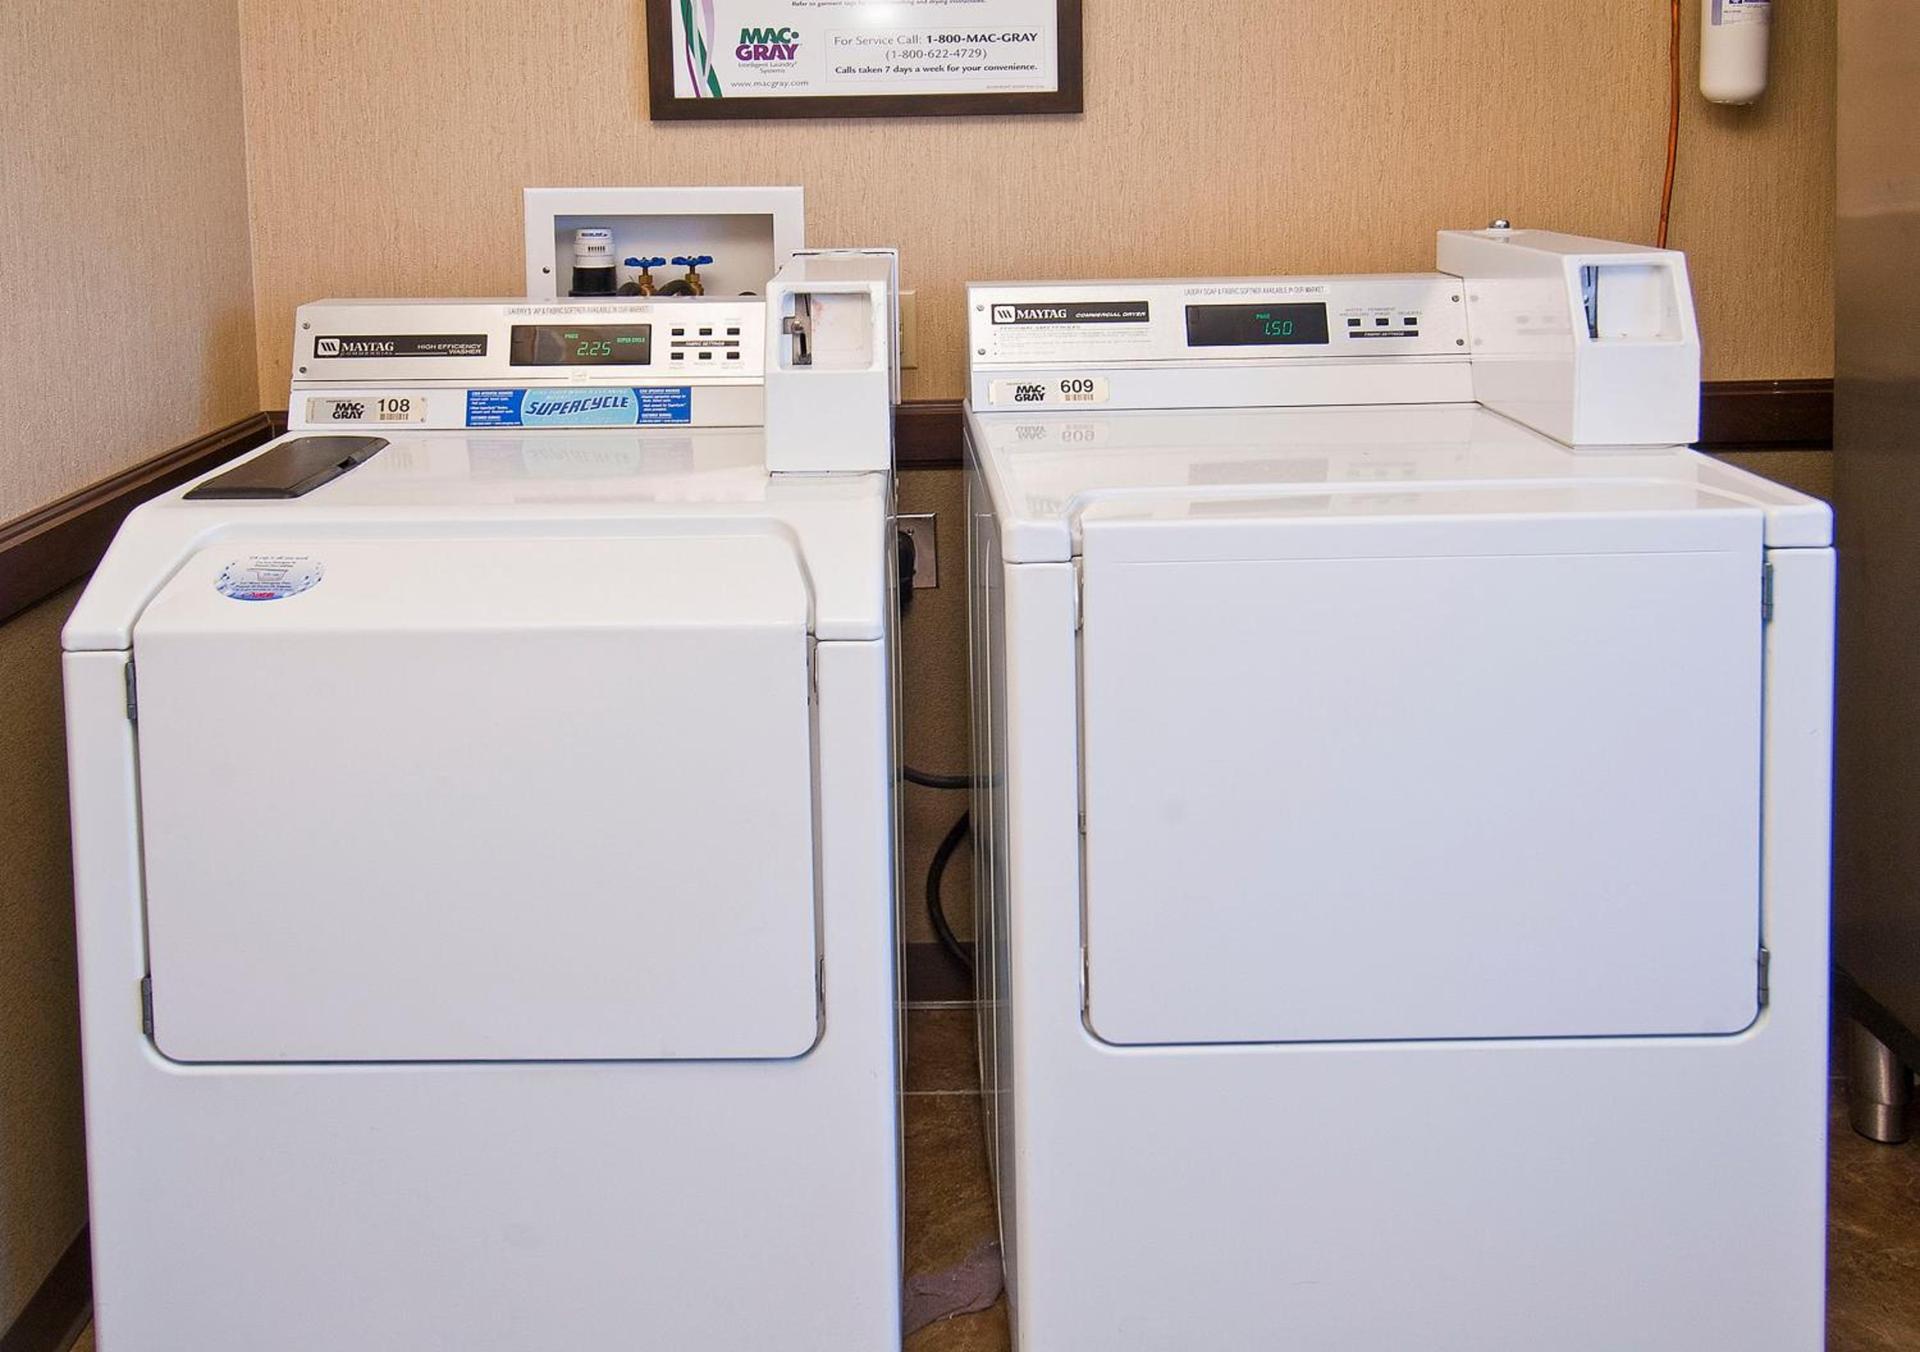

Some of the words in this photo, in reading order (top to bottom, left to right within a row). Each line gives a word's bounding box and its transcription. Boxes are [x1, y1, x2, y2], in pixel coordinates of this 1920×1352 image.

[834, 36, 852, 45] For
[855, 36, 894, 45] Service
[896, 34, 922, 44] Call:
[927, 32, 1038, 43] 1-800-MAC-GRAY
[735, 44, 799, 61] GRAY
[885, 48, 988, 61] (1-800-622-4729)
[835, 66, 856, 74] Calls
[893, 65, 913, 74] days
[946, 64, 960, 72] for
[962, 65, 982, 74] your
[983, 62, 1038, 71] convenience.
[730, 80, 809, 88] www.macgray.com
[1016, 308, 1067, 319] MAYTAG
[341, 342, 395, 352] MAYTAG
[577, 341, 612, 356] 2.25
[1060, 379, 1094, 393] 609
[1014, 393, 1045, 402] GRAY
[377, 398, 410, 412] 108
[526, 396, 629, 416] SUPERCYCLE
[332, 411, 364, 420] GRAY
